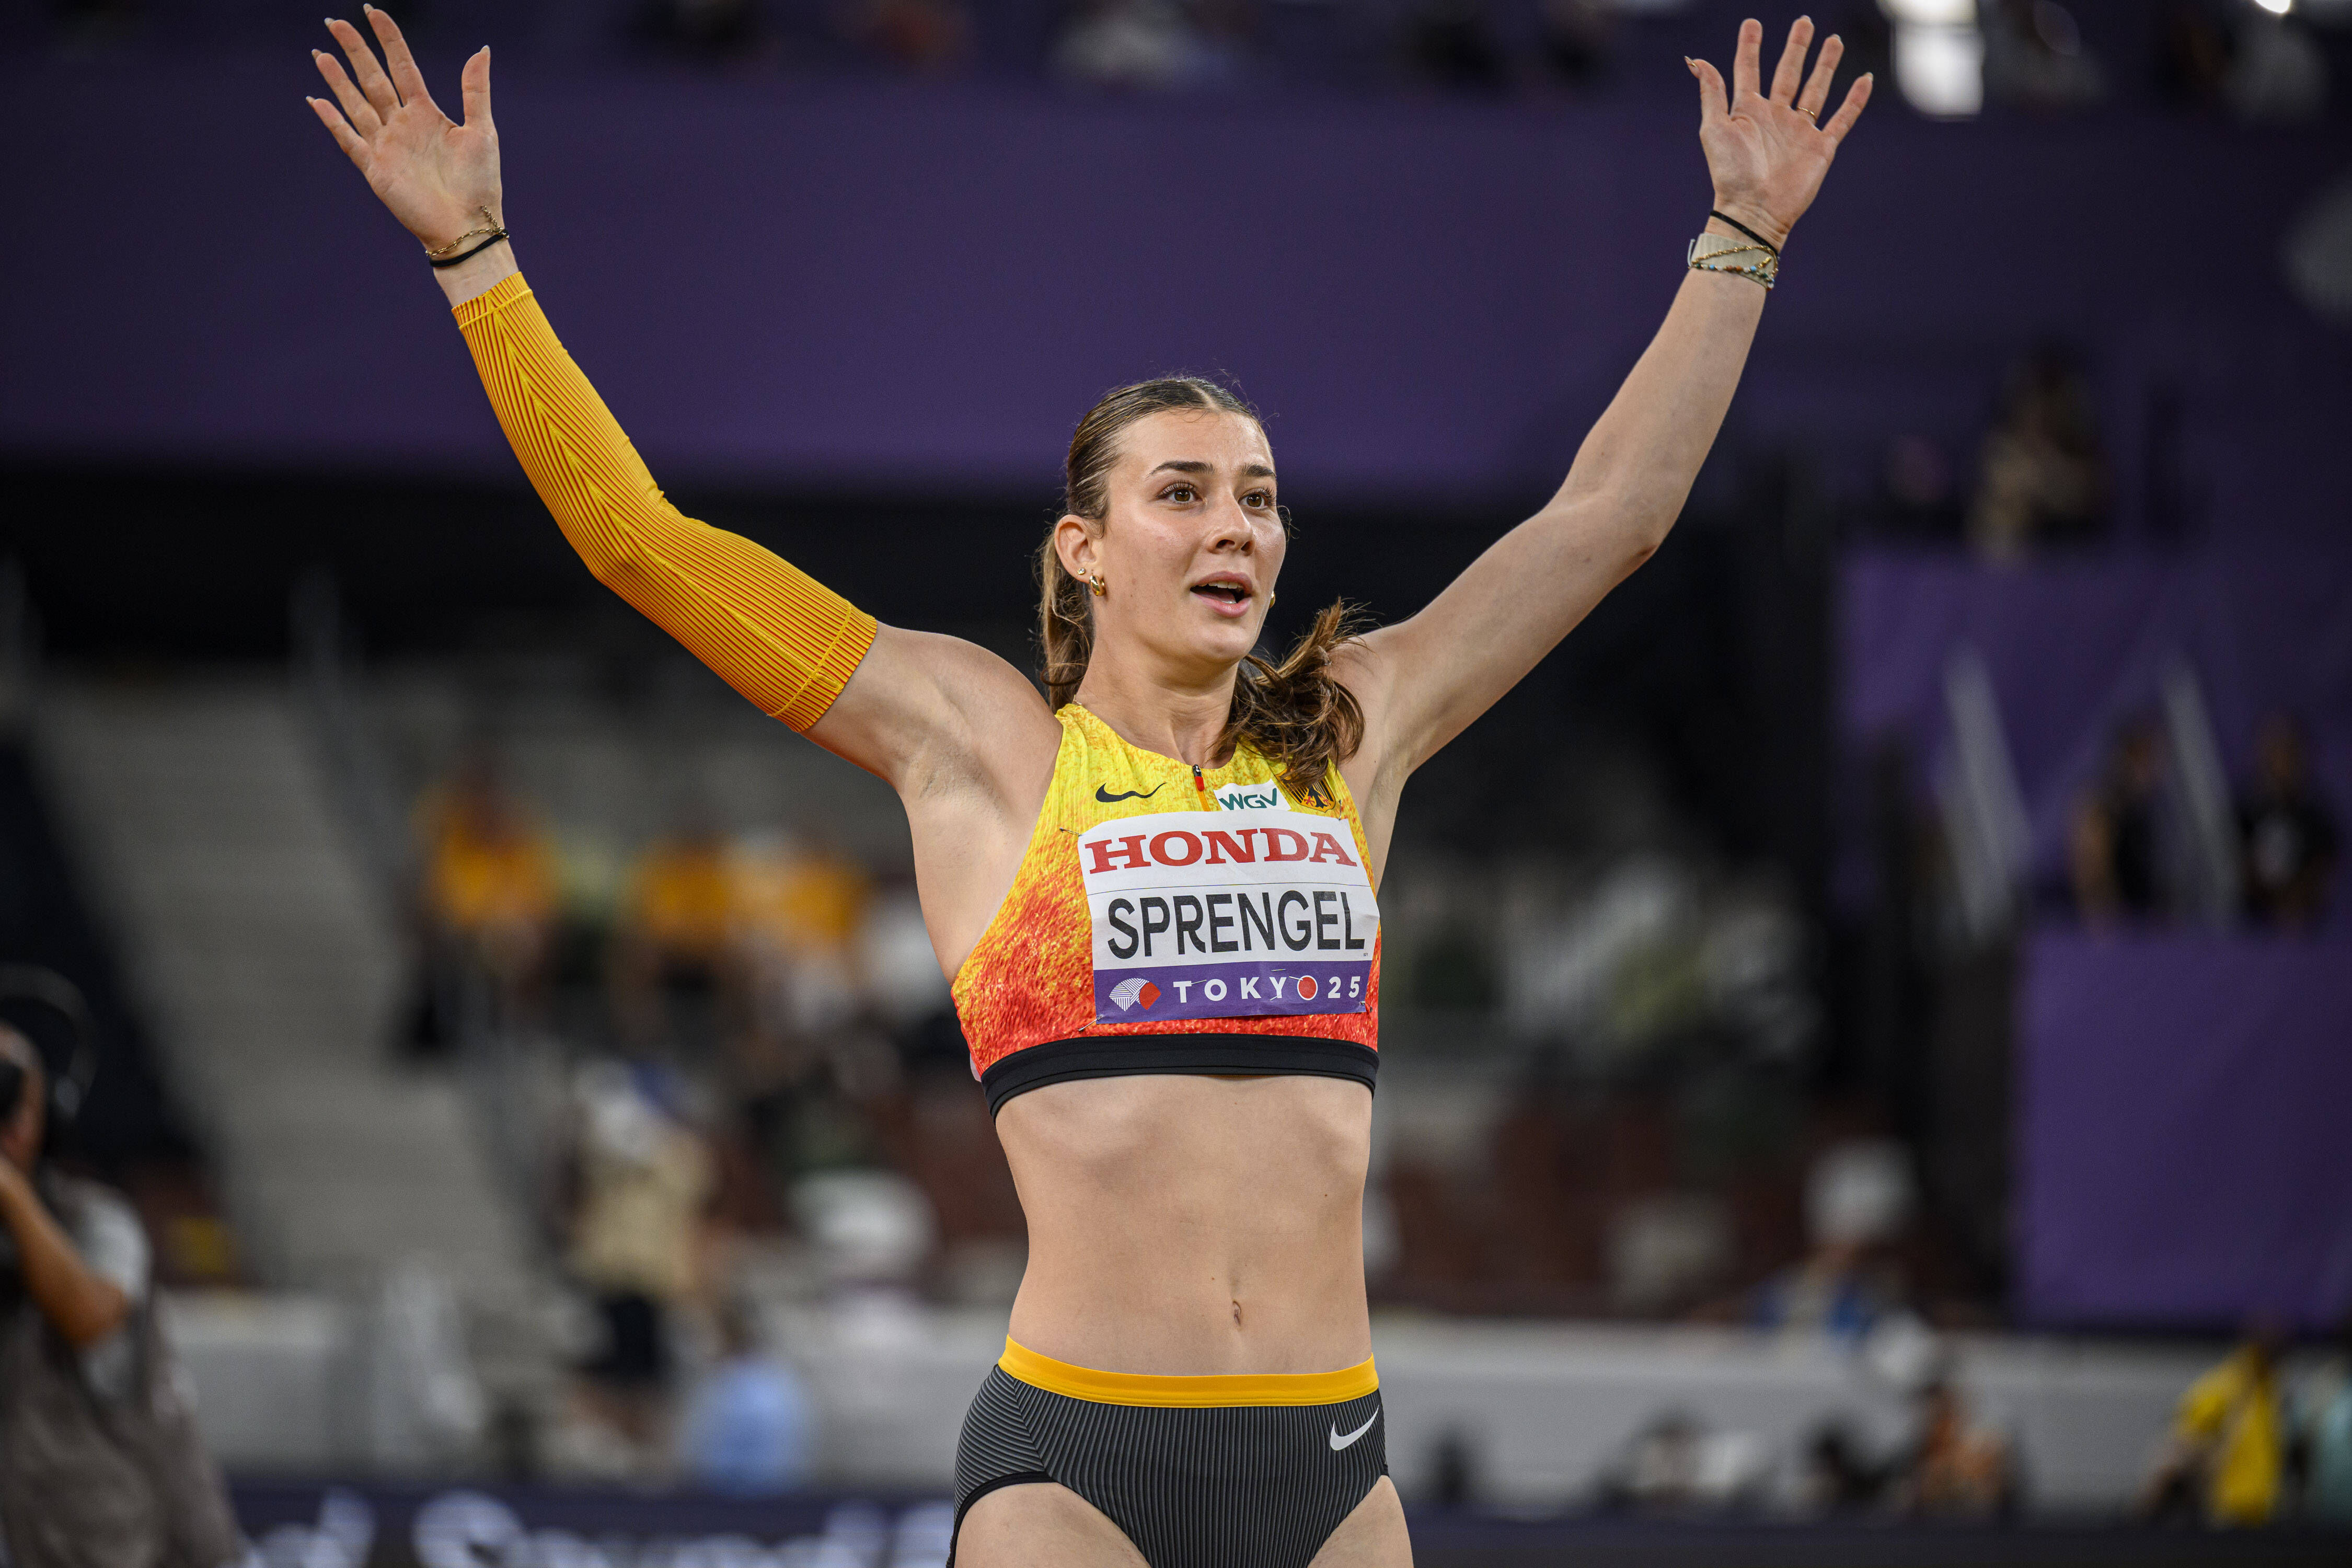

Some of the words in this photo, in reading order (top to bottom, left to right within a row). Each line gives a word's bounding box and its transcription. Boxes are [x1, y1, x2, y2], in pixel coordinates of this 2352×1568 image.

[1218, 788, 1277, 810] WGV
[1085, 828, 1356, 874] HONDA
[1108, 891, 1365, 959] SPRENGEL
[1173, 975, 1318, 1003] TOKYO
[1328, 976, 1361, 998] 25
